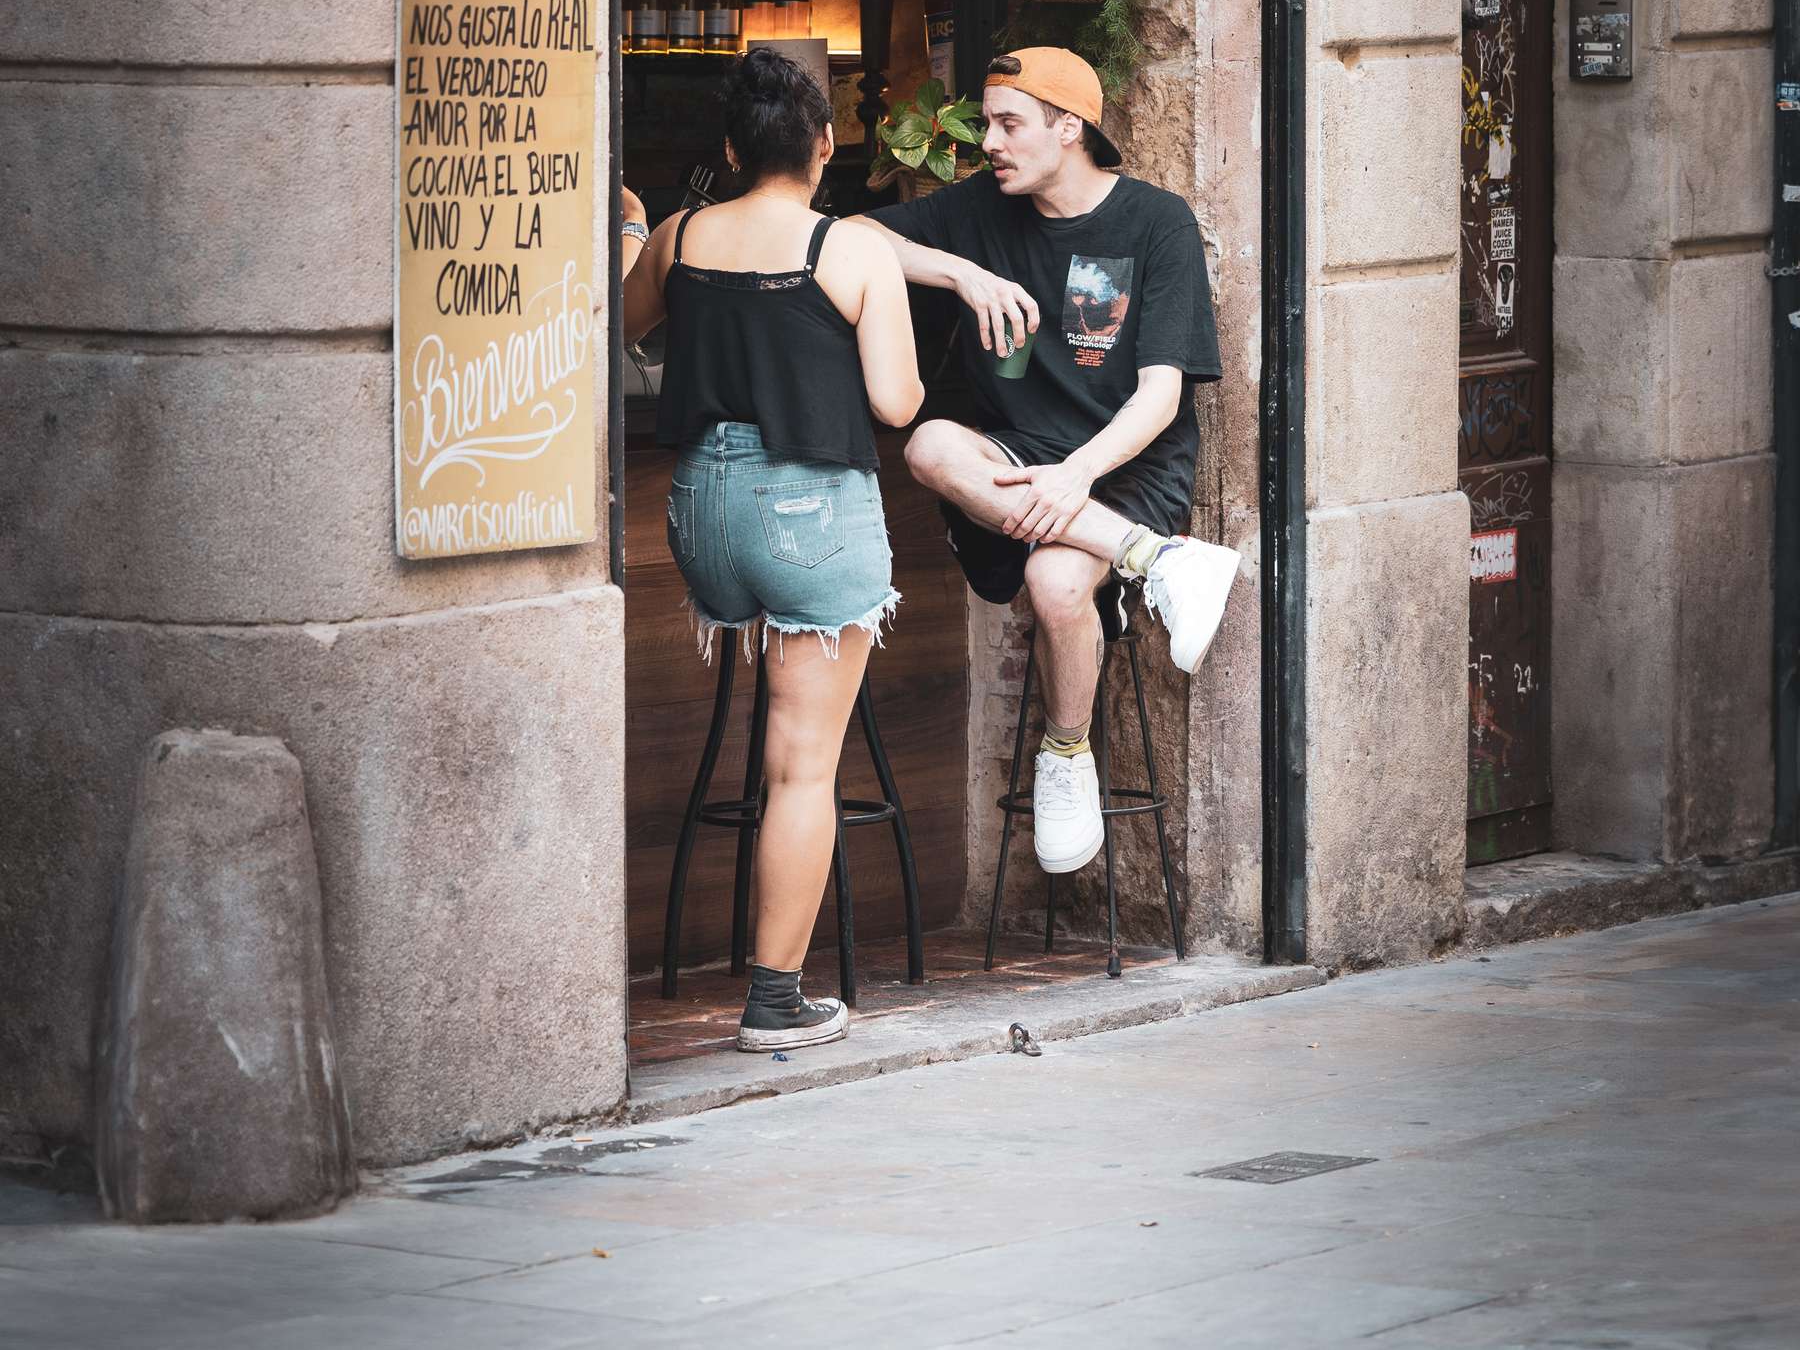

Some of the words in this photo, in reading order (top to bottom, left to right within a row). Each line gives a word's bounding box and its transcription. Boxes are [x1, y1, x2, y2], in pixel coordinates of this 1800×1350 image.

[410, 4, 453, 47] NOS
[458, 4, 516, 49] GUSTA
[405, 56, 429, 95] EL
[436, 56, 548, 98] VERDADERO
[403, 99, 469, 148] AMOR
[479, 101, 508, 151] POR
[514, 104, 537, 144] LA
[494, 154, 518, 197] EL
[526, 151, 579, 196] BUEN
[405, 201, 461, 250] VINO
[514, 202, 542, 249] LA
[1494, 228, 1512, 239] JUICE
[436, 258, 522, 317] COMIDA
[401, 259, 594, 466] Bienvenido
